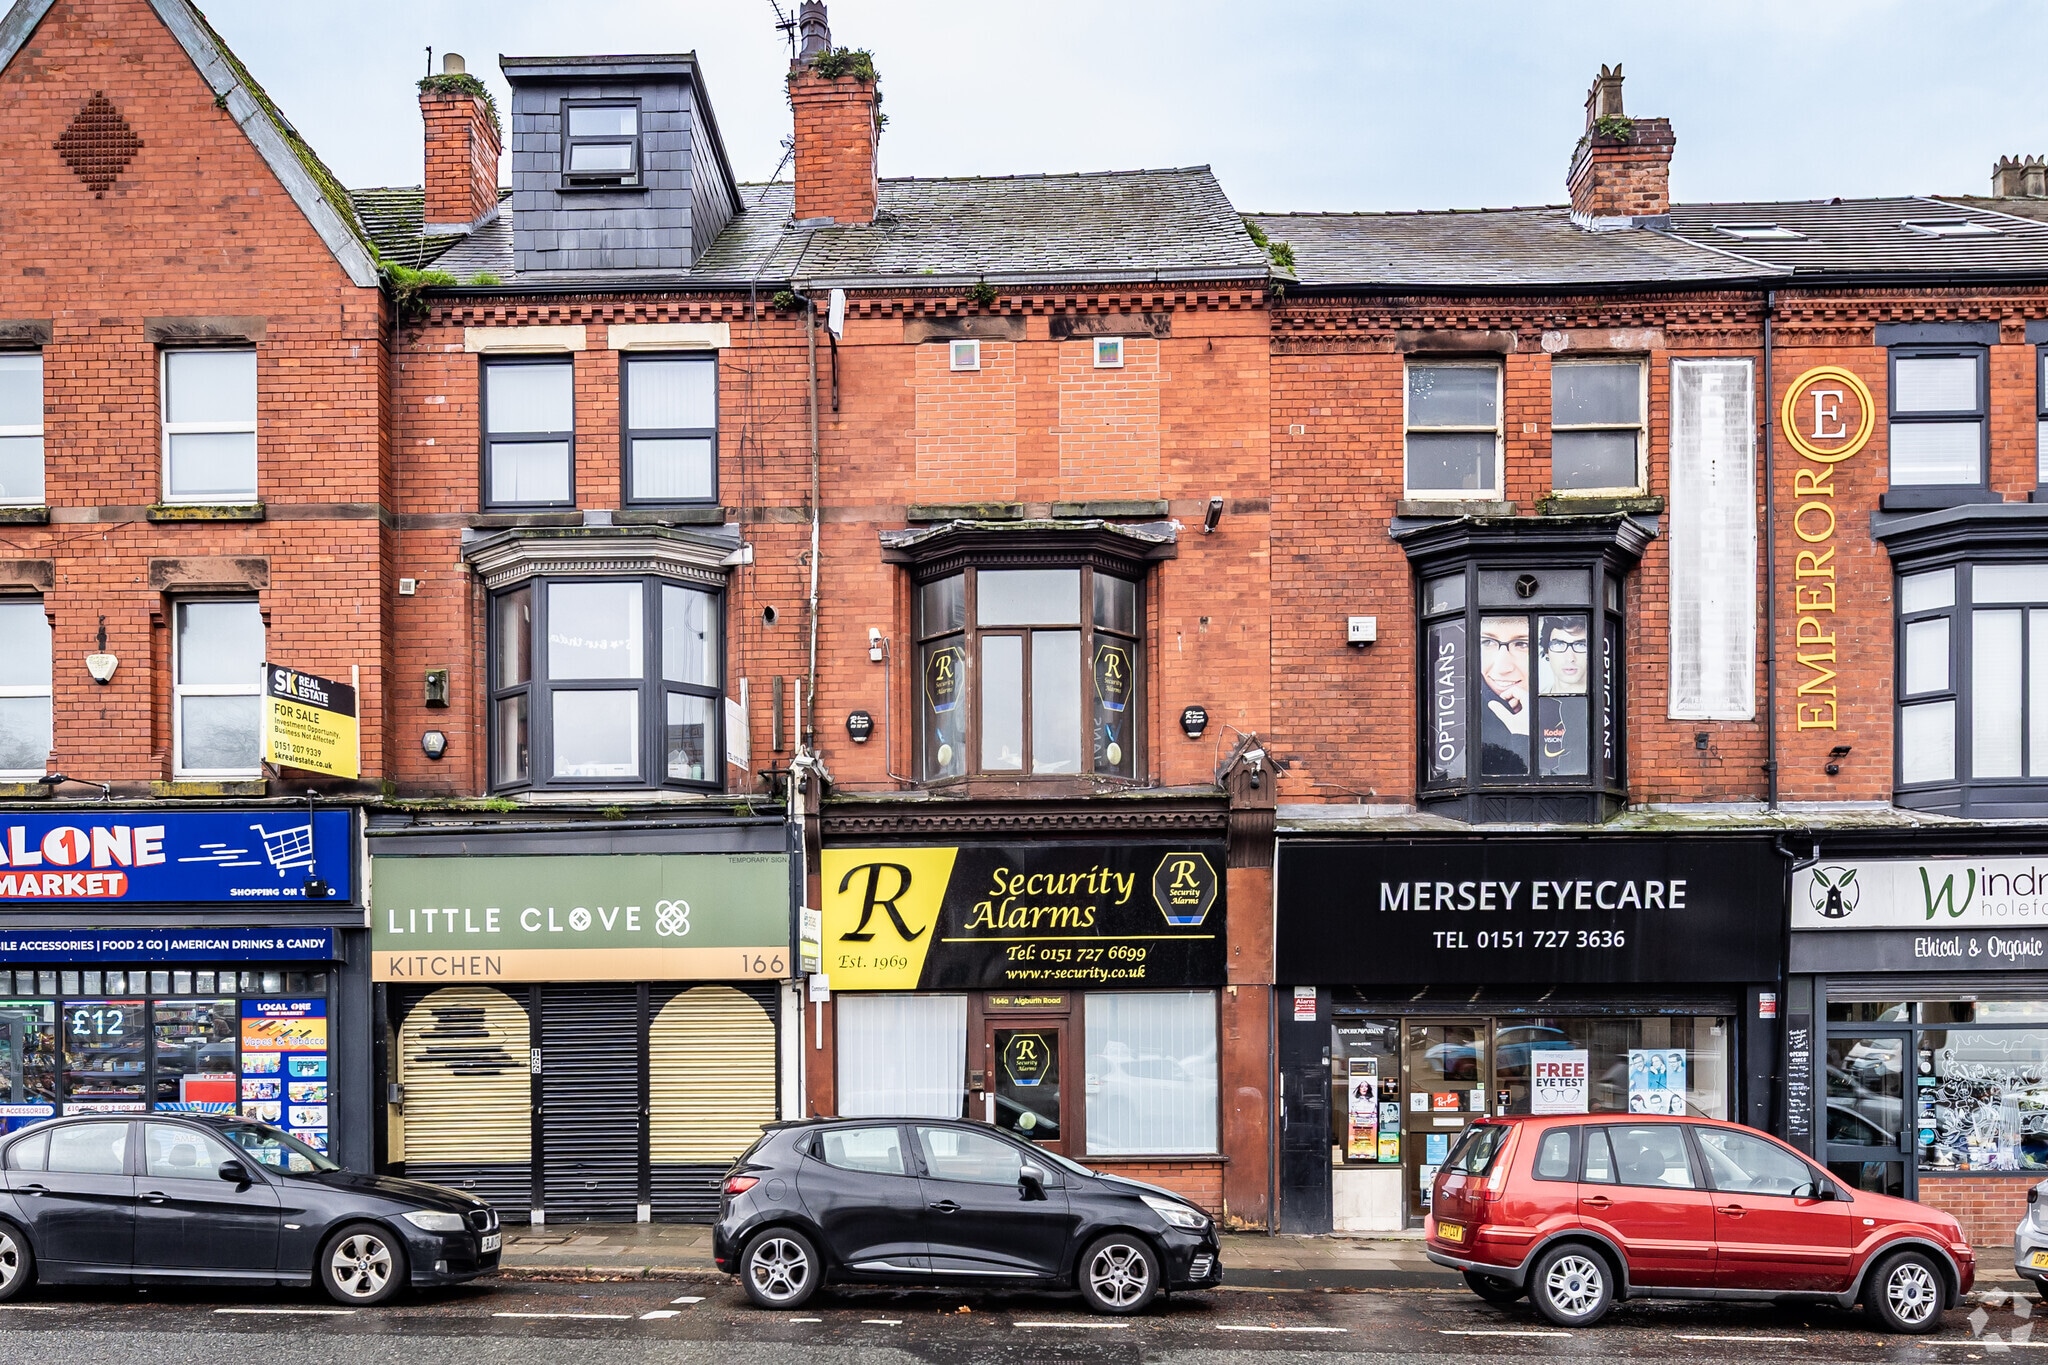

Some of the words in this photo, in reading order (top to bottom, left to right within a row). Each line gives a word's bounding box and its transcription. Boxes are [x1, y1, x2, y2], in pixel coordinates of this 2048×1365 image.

[1810, 389, 1847, 439] E
[1793, 463, 1838, 732] EMPEROR
[935, 655, 954, 681] R
[1104, 653, 1122, 679] R
[274, 669, 298, 696] SK
[298, 675, 321, 691] REAL
[298, 687, 329, 703] ESTATE
[1438, 641, 1455, 762] OPTICIANS
[1603, 637, 1611, 760] OPTICIANS
[274, 703, 293, 718] FOR
[295, 708, 320, 724] SALE
[274, 717, 306, 730] Investment
[307, 724, 341, 739] Opportunity,
[274, 725, 301, 738] Business
[301, 731, 312, 740] Not
[312, 735, 335, 745] Affected
[274, 740, 291, 751] 0151
[292, 744, 305, 753] 207
[305, 747, 322, 757] 9339
[274, 751, 333, 770] skrealestate.co.uk
[988, 864, 1136, 905] Security
[1169, 860, 1201, 888] R
[0, 873, 124, 897] MARKET
[230, 888, 280, 897] SHOPPING
[282, 888, 298, 897] ON
[1169, 887, 1201, 898] Security
[1380, 881, 1522, 912] MERSEY
[1531, 879, 1688, 911] EYECARE
[838, 861, 927, 943] R
[1169, 896, 1200, 906] Alarms
[388, 907, 501, 934] LITTLE
[520, 906, 642, 933] CLOVE
[963, 899, 1096, 930] Alarms
[0, 941, 18, 951] ILE
[19, 940, 95, 951] ACCESSORIES
[102, 940, 136, 950] FOOD
[137, 940, 144, 950] 2
[145, 940, 163, 950] GO
[171, 940, 230, 950] AMERICAN
[232, 939, 275, 950] DRINKS
[276, 940, 284, 949] &
[286, 938, 326, 950] CANDY
[1433, 931, 1469, 949] TEL
[1477, 931, 1524, 949] 0151
[1532, 931, 1570, 949] 727
[1575, 930, 1626, 948] 3636
[1914, 936, 1963, 958] Ethical
[1968, 938, 1982, 957] &
[1987, 936, 2044, 962] Organic
[390, 956, 502, 977] KITCHEN
[742, 953, 785, 974] 166
[838, 953, 868, 969] Est.
[872, 954, 908, 970] 1969
[1006, 946, 1036, 962] Tel:
[1040, 947, 1072, 961] 0151
[1076, 947, 1104, 963] 727
[1107, 946, 1147, 963] 6699
[1005, 965, 1147, 983] www.r-security.co.uk
[257, 1003, 288, 1011] LOCAL
[290, 1002, 312, 1010] ONE
[992, 997, 1009, 1005] 164a
[1013, 997, 1042, 1006] Aigburth
[72, 1009, 124, 1035] £12
[243, 1036, 273, 1049] Vapes
[276, 1036, 285, 1046] &
[288, 1035, 325, 1046] Tobacco
[1015, 1039, 1038, 1060] R
[1536, 1063, 1585, 1078] FREE
[1536, 1078, 1556, 1087] EYE
[1558, 1078, 1585, 1087] TEST
[6, 1107, 50, 1115] ACCESSORIES
